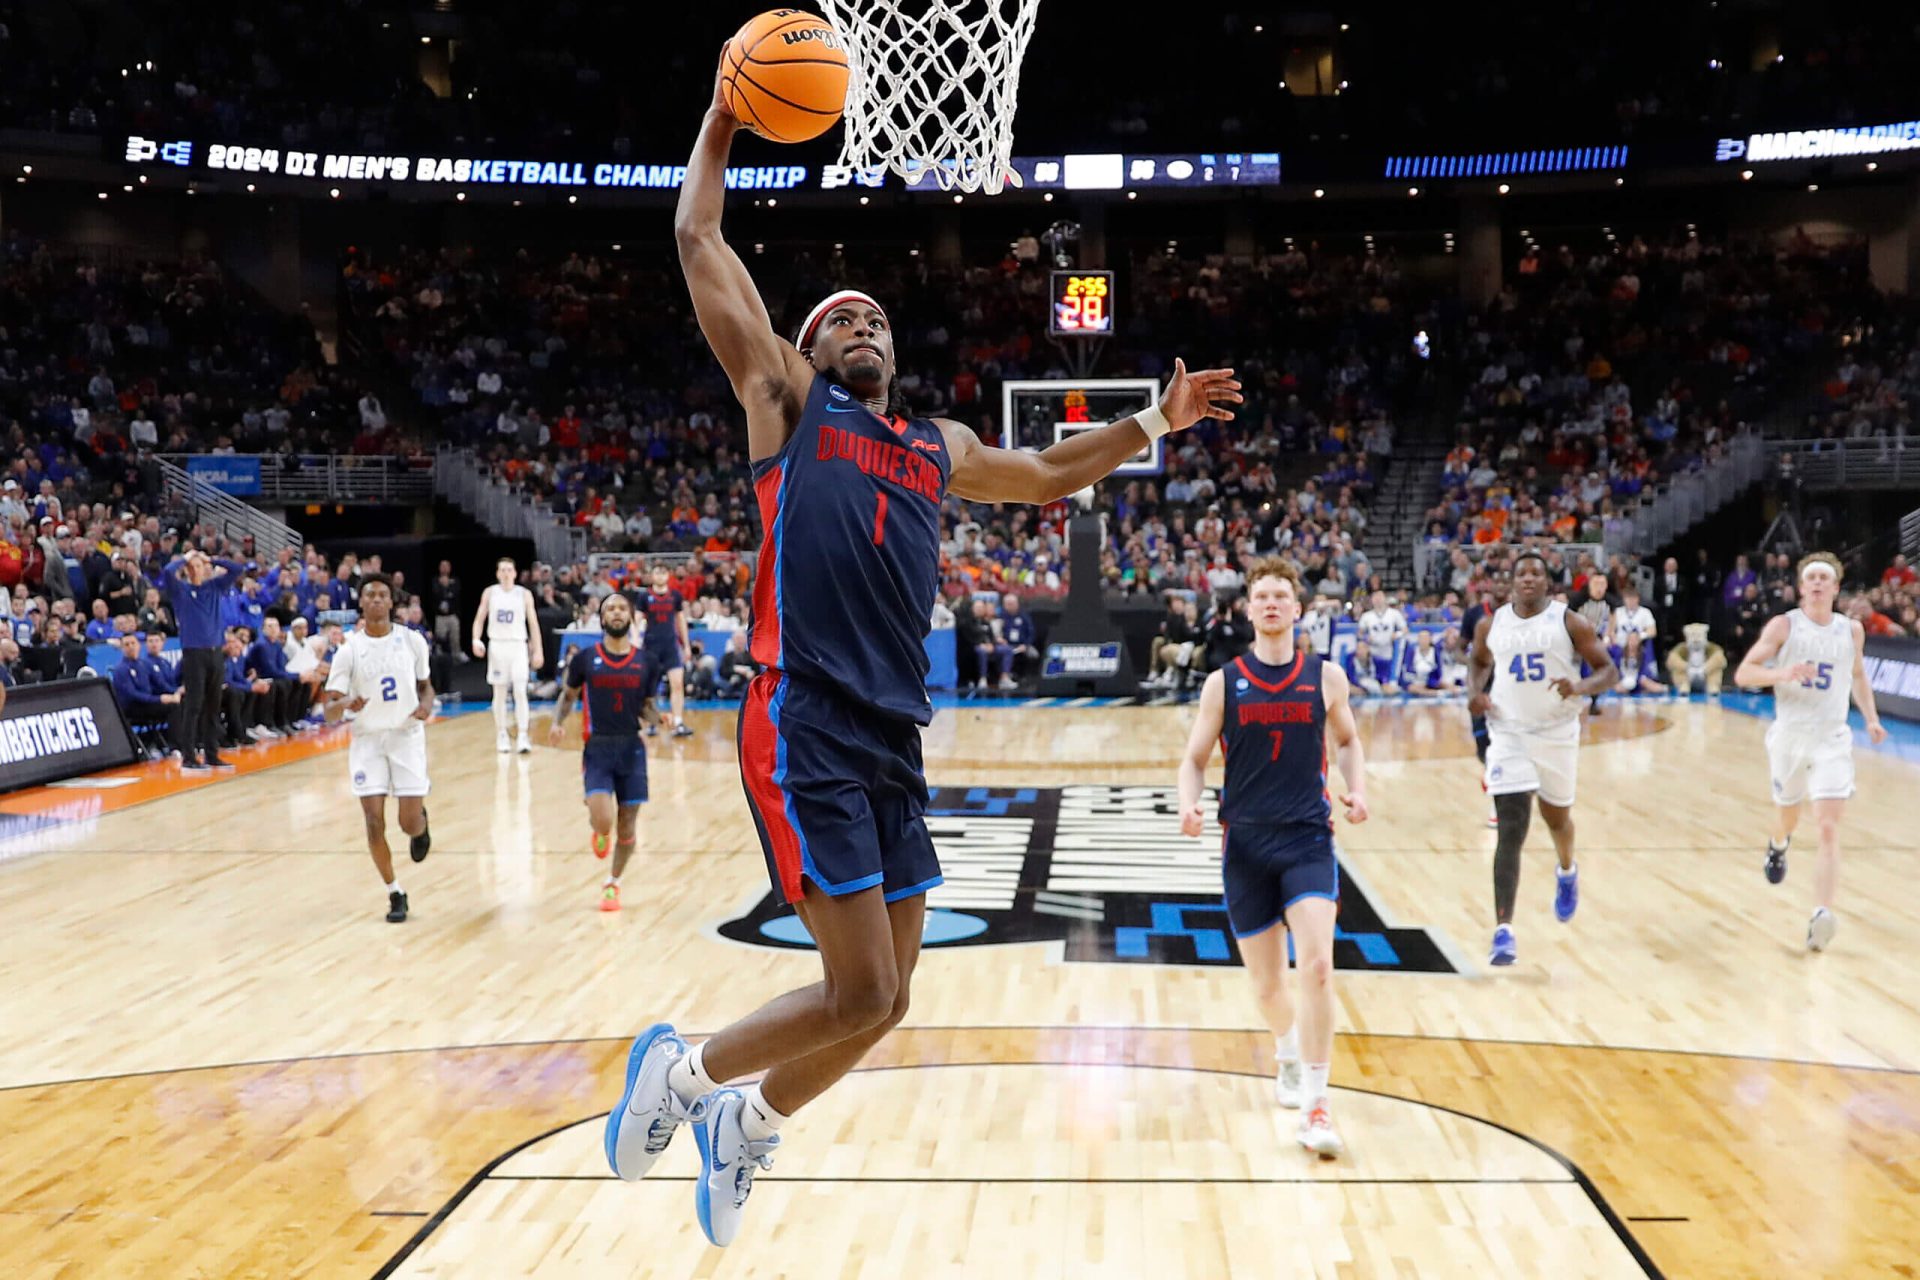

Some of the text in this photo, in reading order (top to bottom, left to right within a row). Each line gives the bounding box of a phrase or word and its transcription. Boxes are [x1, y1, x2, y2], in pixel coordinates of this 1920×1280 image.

[207, 144, 807, 190] 2024 DI MEN'S BASKETBALL CHAMPNSHIP
[1063, 296, 1102, 328] 28
[816, 425, 943, 505] DUQUESNE
[873, 491, 889, 545] 1
[497, 609, 514, 624] 20
[1508, 653, 1546, 682] 45
[380, 676, 398, 702] 2
[1269, 730, 1284, 762] 7
